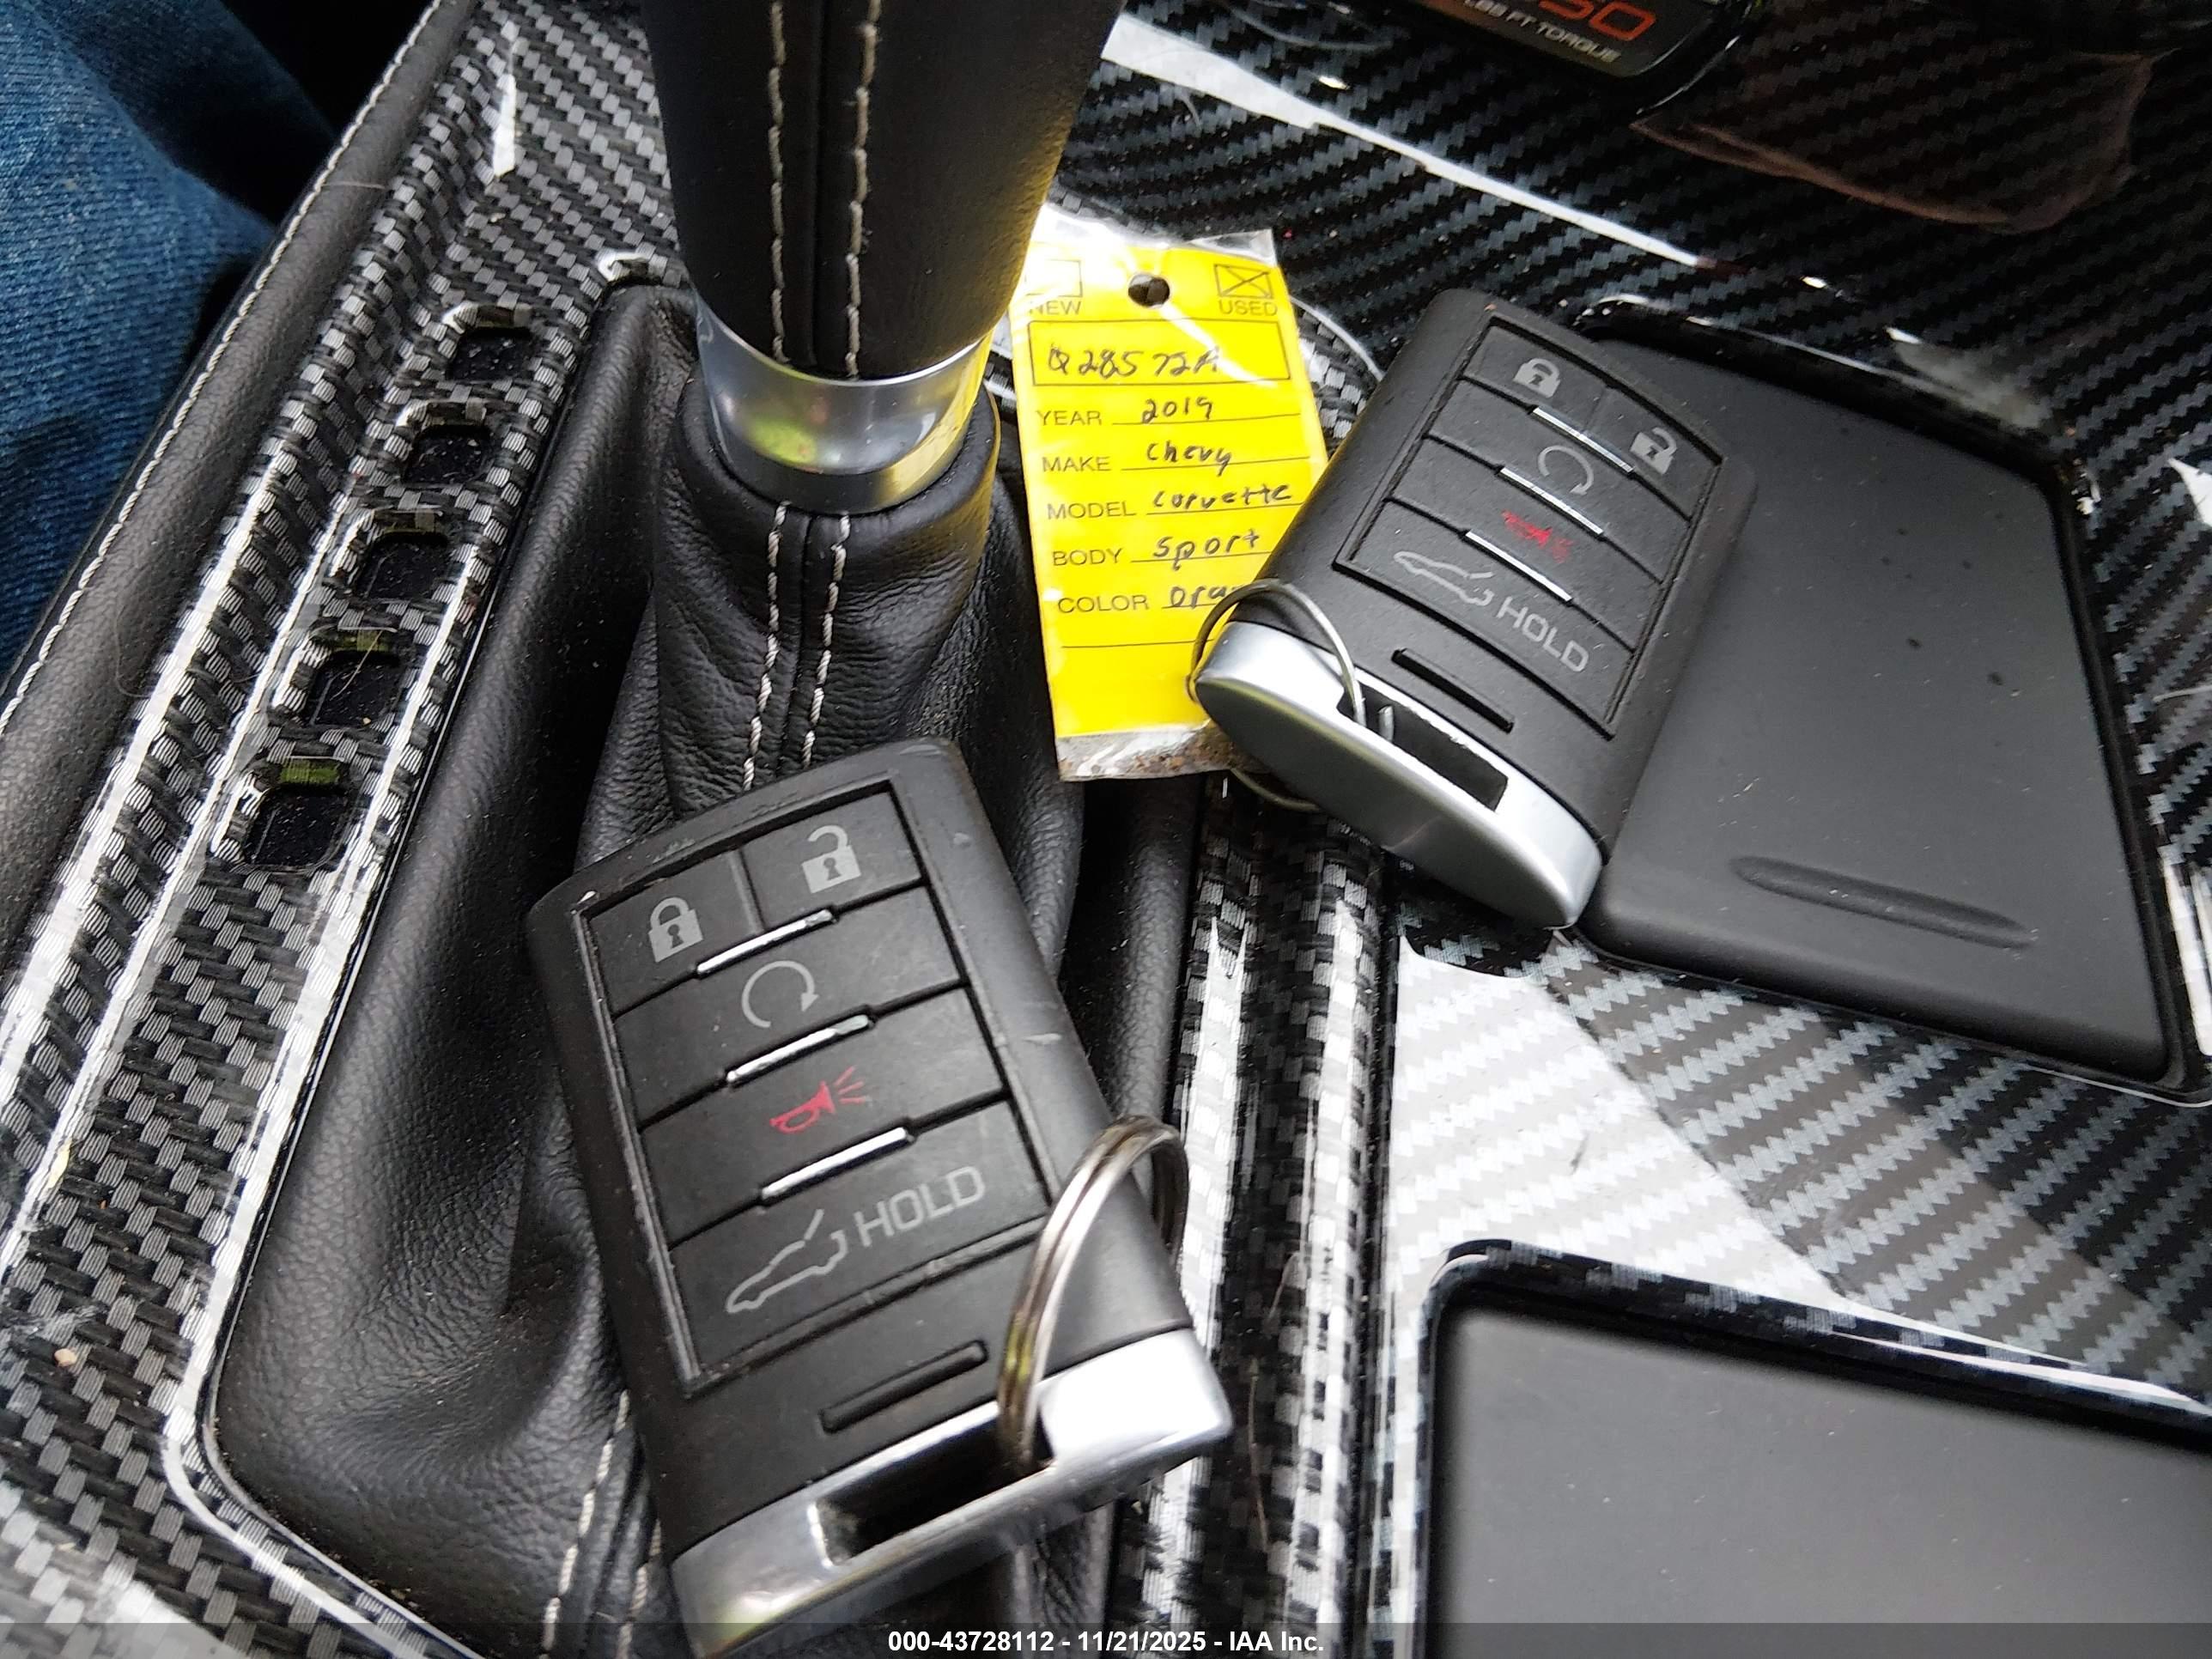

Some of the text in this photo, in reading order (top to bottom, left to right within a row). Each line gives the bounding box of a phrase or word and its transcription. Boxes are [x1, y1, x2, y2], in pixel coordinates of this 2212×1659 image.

[1506, 9, 1537, 27] FT
[1536, 21, 1621, 63] TORQUE
[1218, 299, 1278, 317] USED
[1036, 397, 1212, 427] YEAR 2019
[1042, 456, 1111, 473] MAKE
[1047, 501, 1137, 520] MODEL
[1053, 547, 1122, 567] BODY
[1056, 594, 1149, 614] COLOR
[1496, 596, 1589, 672] HOLD
[854, 1166, 986, 1247] HOLD
